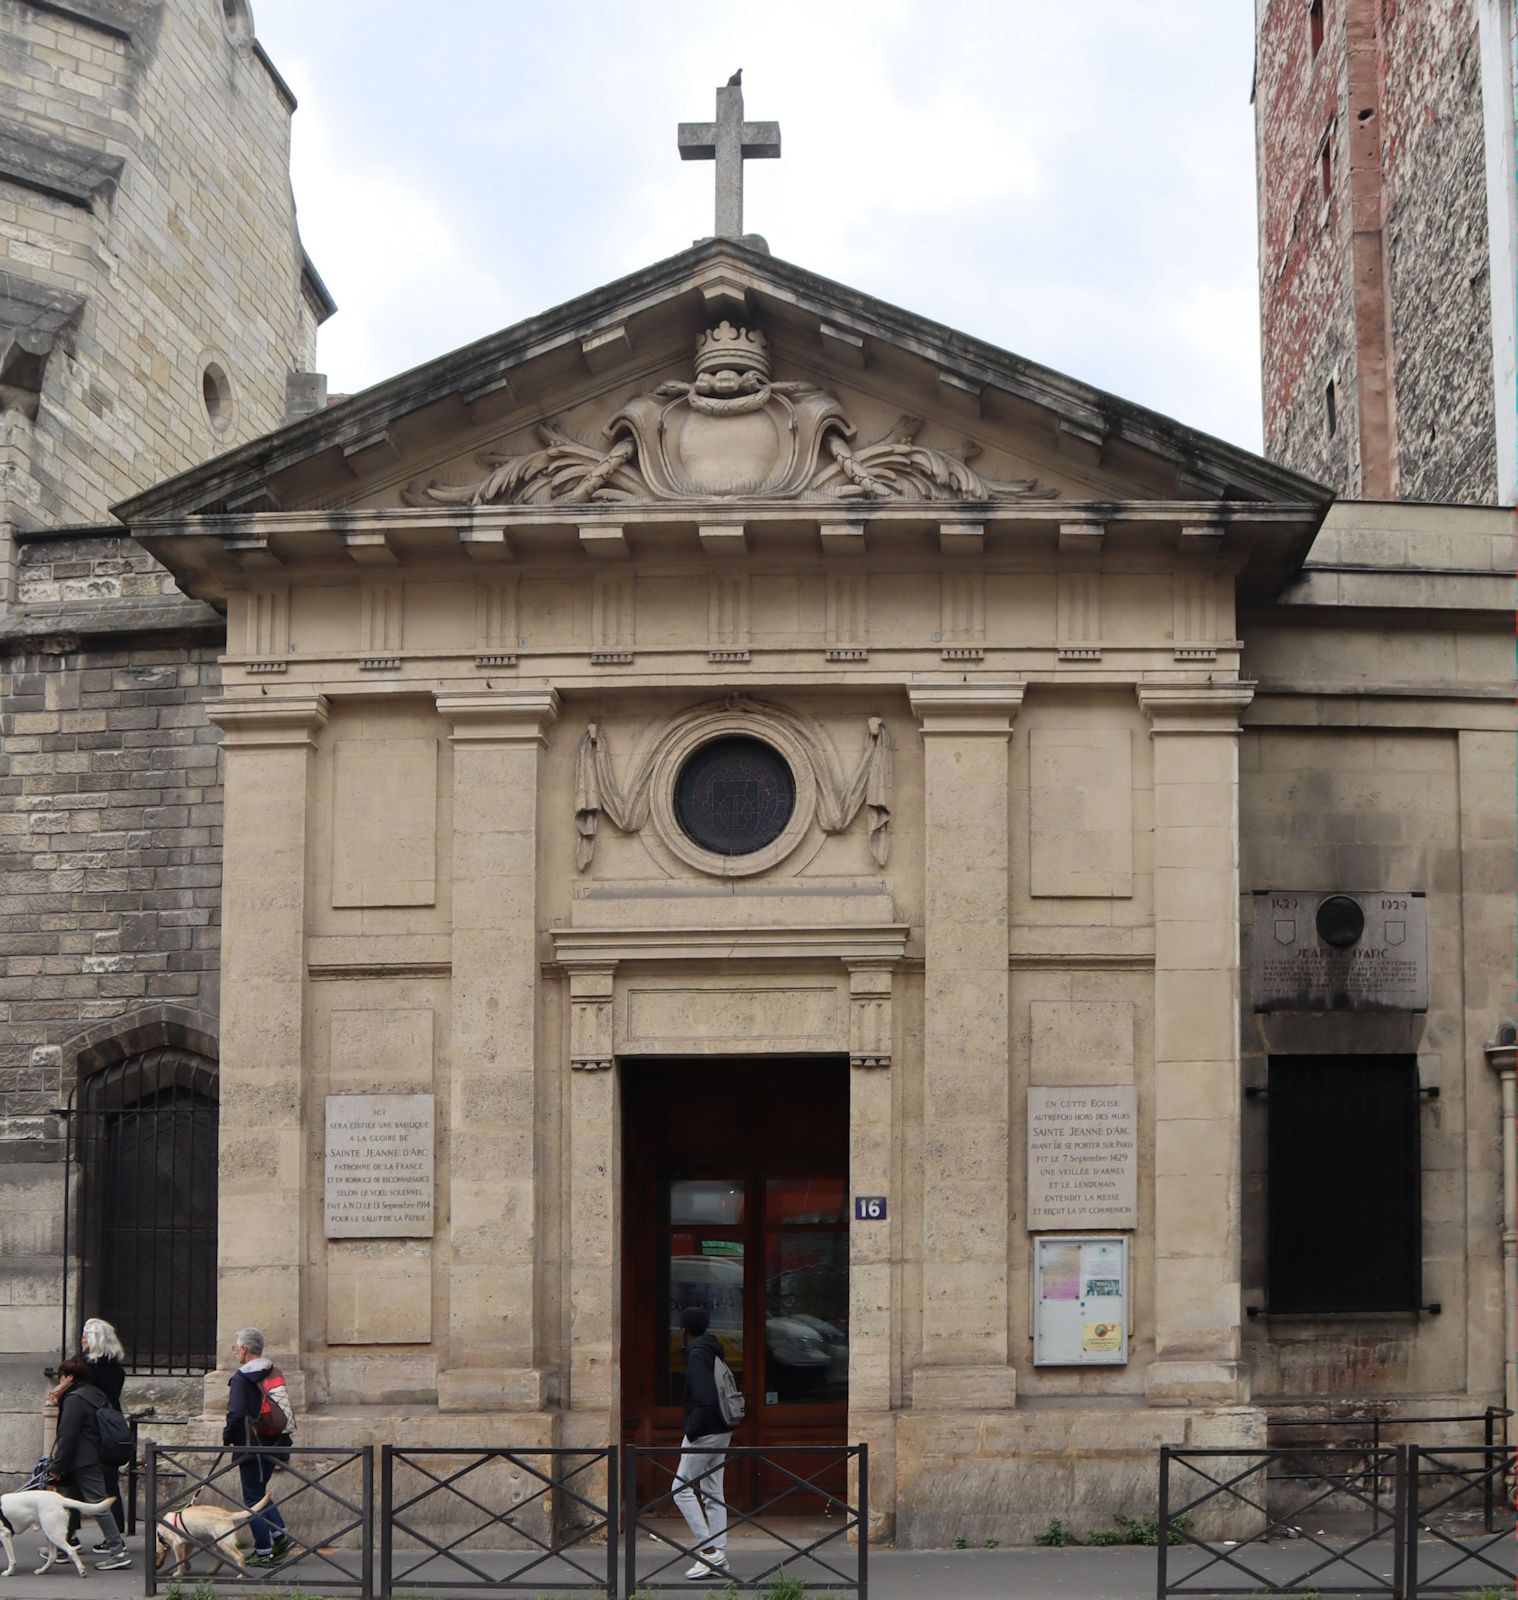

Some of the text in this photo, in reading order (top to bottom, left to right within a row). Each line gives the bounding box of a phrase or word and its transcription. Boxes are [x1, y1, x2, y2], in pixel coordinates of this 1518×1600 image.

[1272, 898, 1298, 909] 1429
[1381, 900, 1408, 910] 1929
[1060, 1100, 1088, 1108] CETTE
[1075, 1113, 1094, 1121] HORS
[394, 1121, 430, 1129] BASILIQUE
[1032, 1126, 1131, 1137] SAINTE JEANNE D'ARC
[369, 1134, 397, 1142] GLOIRE
[1102, 1141, 1114, 1149] SUR
[1115, 1140, 1134, 1148] PARIS
[330, 1149, 360, 1158] SAINTE
[365, 1148, 400, 1157] JEANNE
[1062, 1154, 1068, 1163] 7
[1069, 1154, 1108, 1164] Septembre
[1110, 1153, 1128, 1162] 1429
[396, 1162, 423, 1170] FRANCE
[1040, 1168, 1055, 1176] UNE
[1084, 1194, 1094, 1202] LA
[373, 1201, 380, 1209] 13
[382, 1201, 416, 1211] Septembre
[416, 1200, 431, 1208] 1914
[860, 1199, 880, 1217] 16
[1043, 1207, 1065, 1216] REÇUT
[1067, 1207, 1077, 1215] LA
[1089, 1207, 1132, 1215] COMMUNION
[404, 1214, 425, 1222] PATRIE
